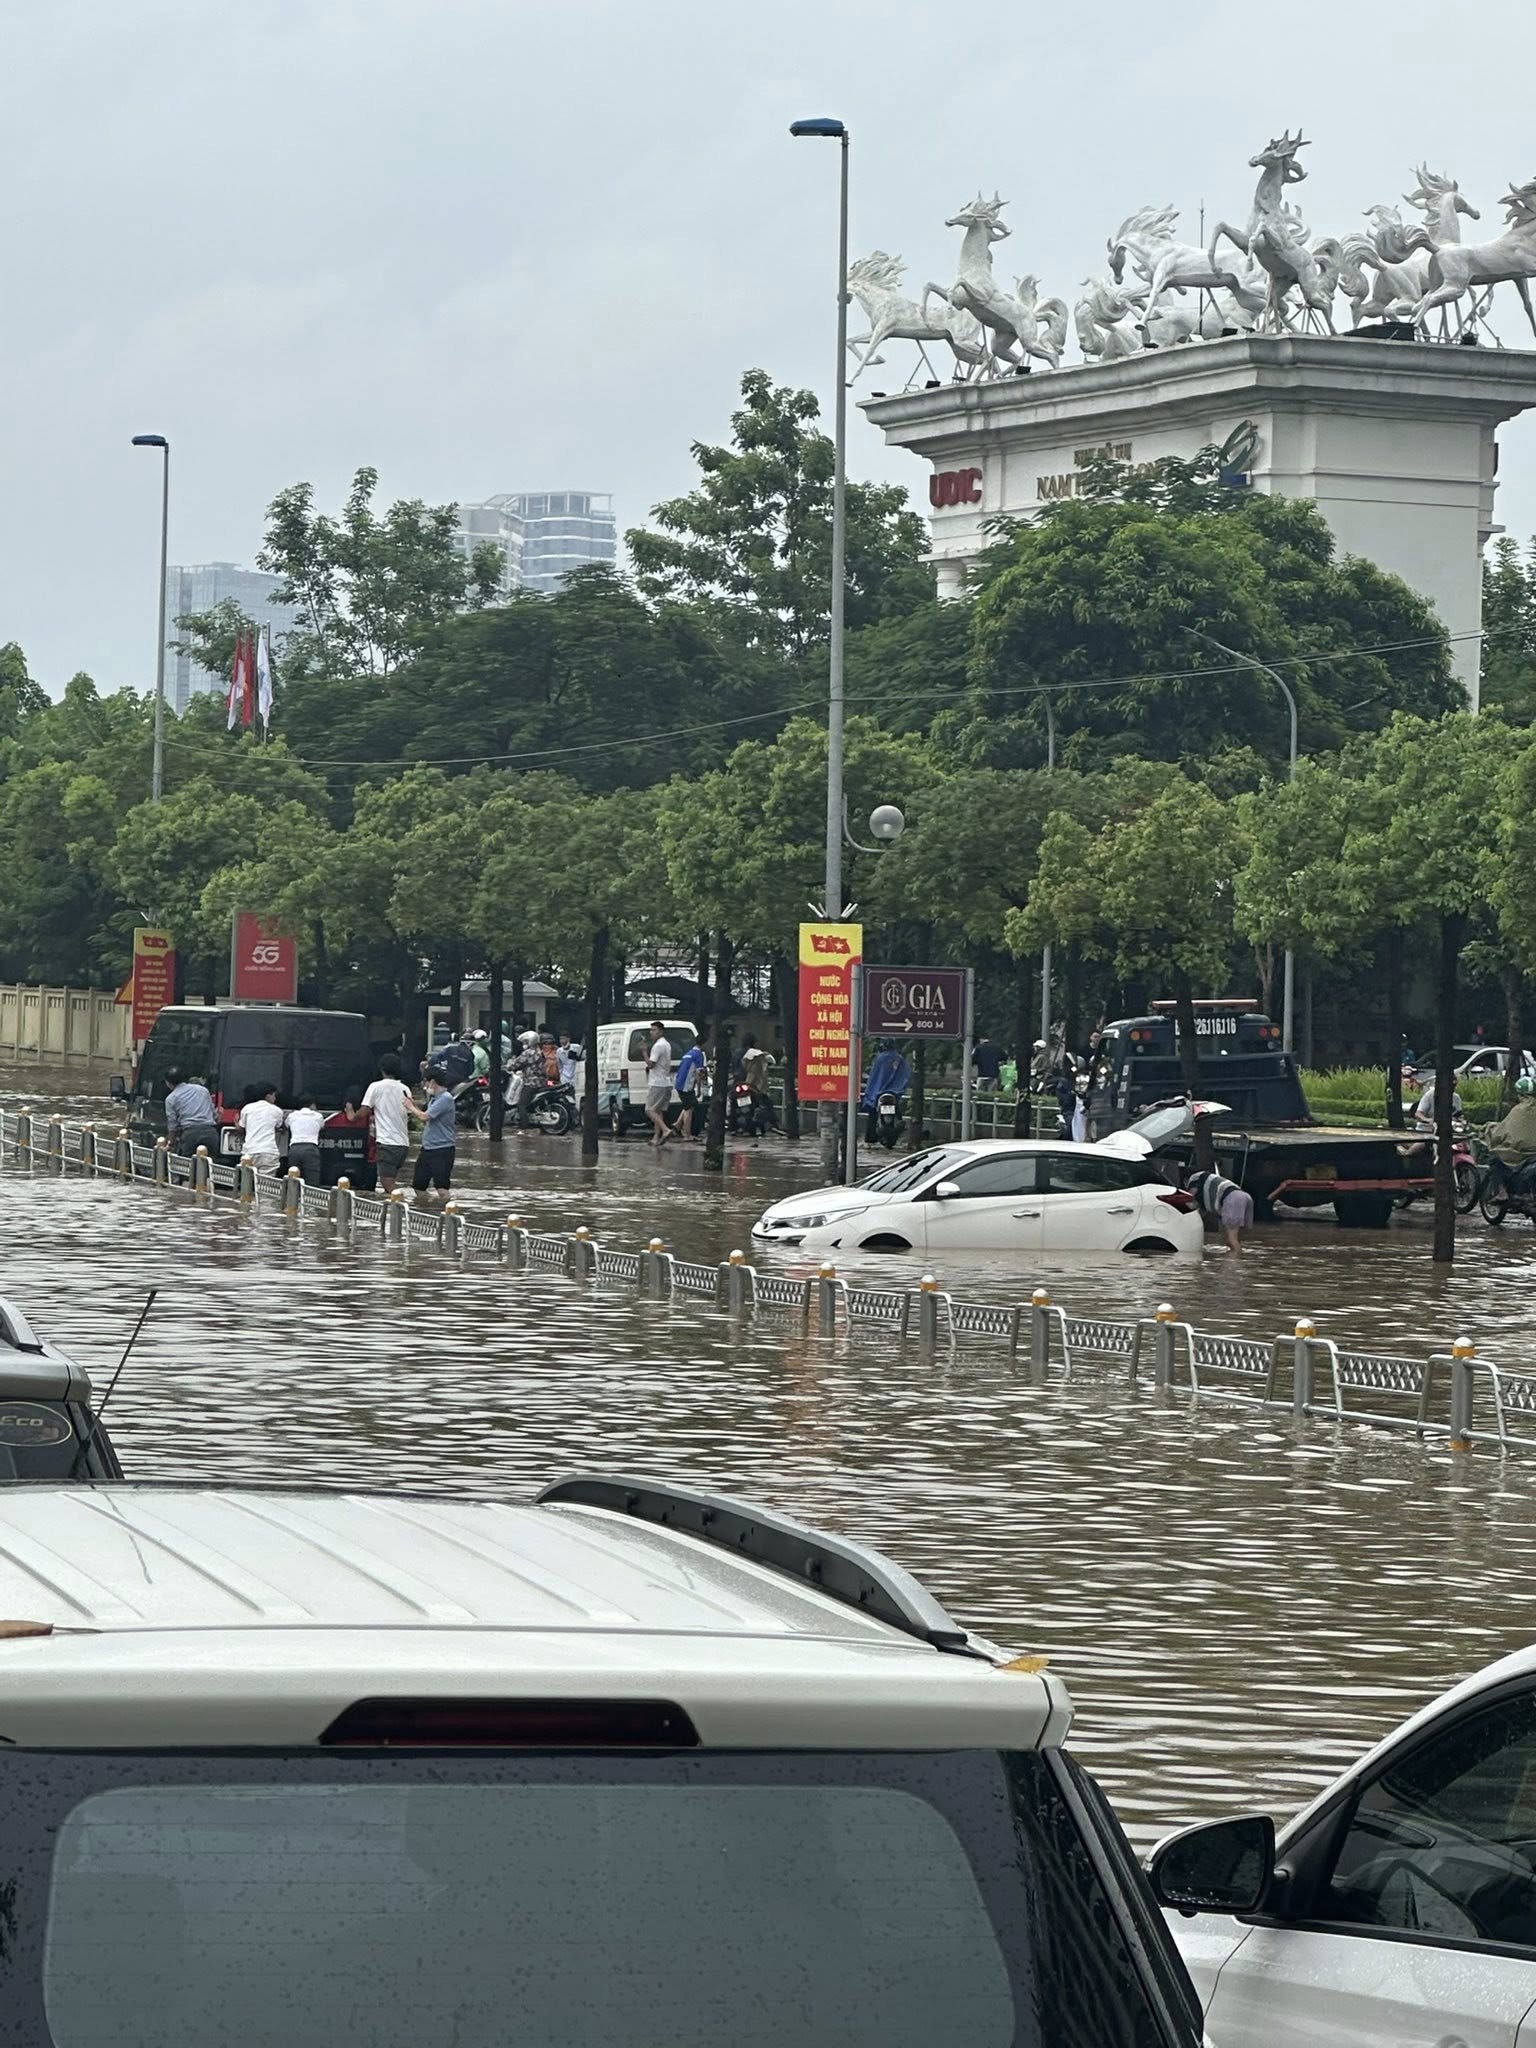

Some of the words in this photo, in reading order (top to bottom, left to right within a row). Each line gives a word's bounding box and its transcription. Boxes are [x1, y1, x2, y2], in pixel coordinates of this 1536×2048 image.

[930, 467, 982, 507] UDIC
[1036, 473, 1072, 500] NAM
[252, 945, 279, 965] 5G
[819, 974, 841, 988] NƯỚC
[810, 991, 832, 1006] CỘNG
[833, 992, 849, 1005] HÒA
[909, 984, 946, 1010] GIA
[817, 1009, 828, 1022] XÃ
[829, 1010, 842, 1025] HỘI
[809, 1026, 825, 1040] CHỦ
[826, 1028, 849, 1040] NGHĨA
[811, 1044, 828, 1060] VIỆT
[829, 1047, 847, 1058] NAM
[806, 1062, 830, 1076] MUÔN
